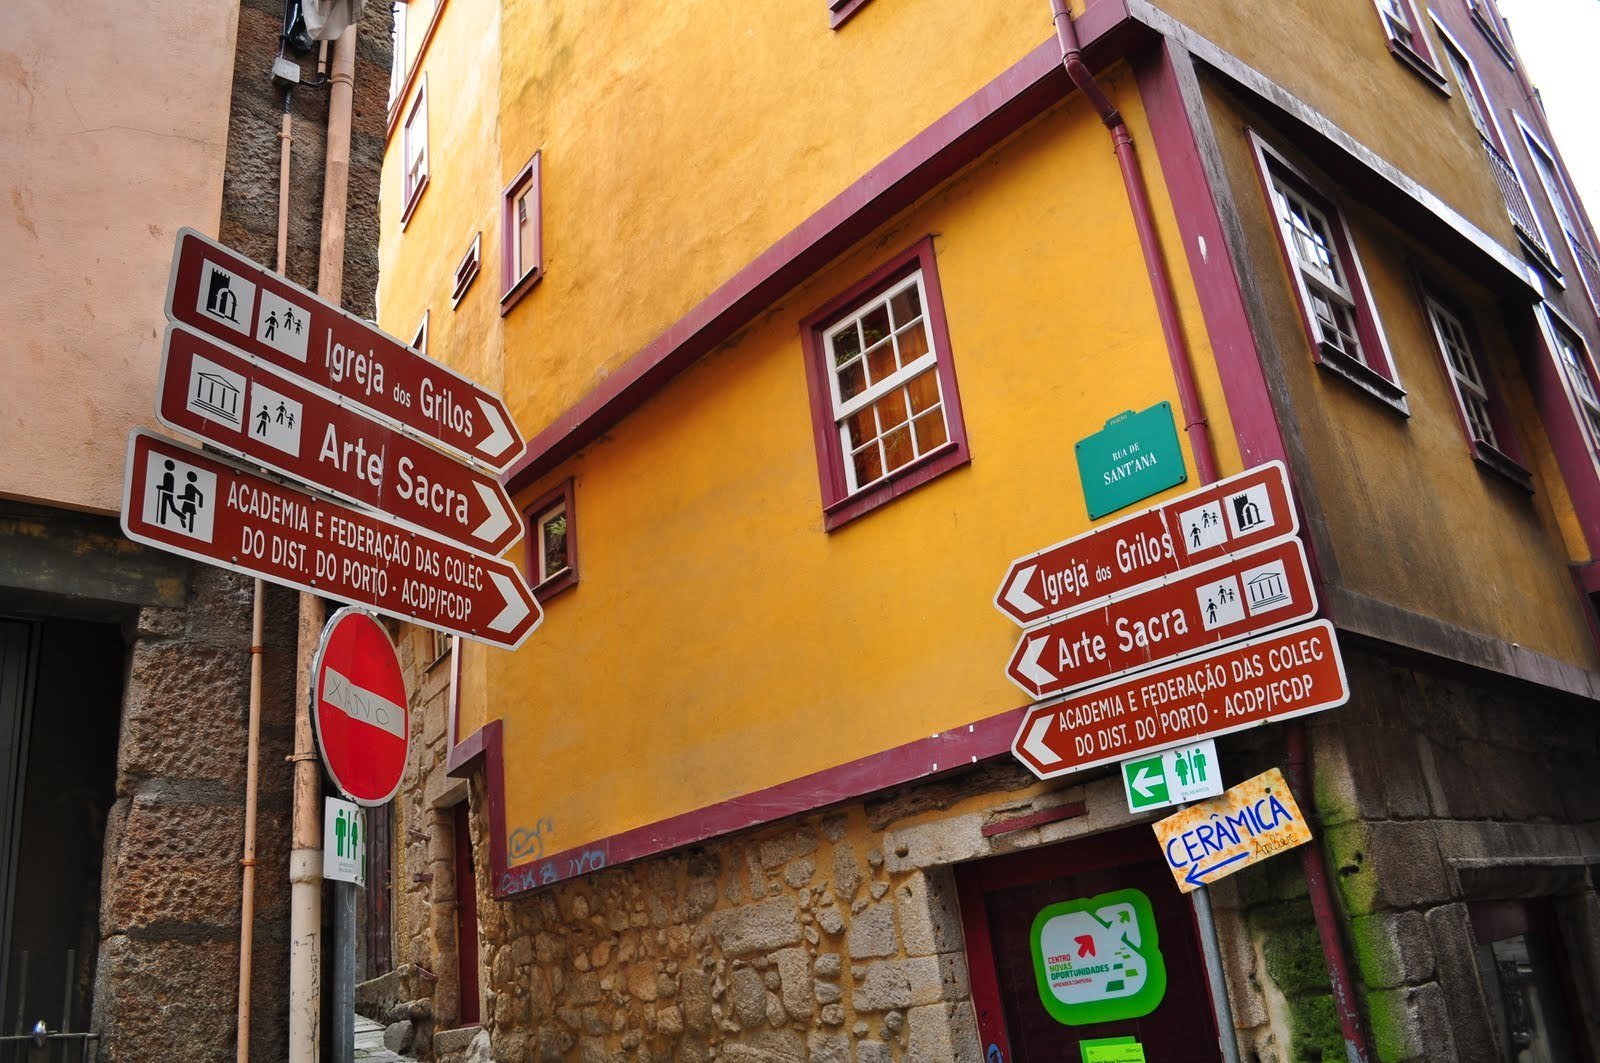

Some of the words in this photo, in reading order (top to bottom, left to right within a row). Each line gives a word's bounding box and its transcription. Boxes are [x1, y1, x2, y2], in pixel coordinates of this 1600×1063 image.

[325, 327, 385, 396] Igreja
[393, 382, 411, 408] dos
[420, 377, 473, 438] Grilos
[319, 422, 383, 487] Arte
[396, 456, 469, 526] Sacra
[1103, 452, 1158, 486] SANT'ANA
[1112, 448, 1128, 462] RUA
[1129, 442, 1140, 454] DE
[227, 480, 309, 534] ACADEMIA
[315, 511, 324, 538] E
[330, 517, 411, 569] FEDERAÇÃO
[415, 545, 441, 577] DAS
[445, 554, 484, 592] COLEC
[1041, 558, 1089, 605] Igreja
[1095, 565, 1112, 582] dos
[1116, 531, 1174, 574] Grilos
[242, 525, 265, 560] DO
[271, 535, 309, 574] DIST.
[315, 549, 337, 582] DO
[343, 557, 388, 597] PORTO
[401, 577, 472, 622] ACDP/FCDP
[1058, 630, 1107, 673] Arte
[1115, 608, 1189, 652] Sacra
[1058, 694, 1125, 732] ACADEMIA
[1128, 691, 1138, 712] E
[1140, 663, 1227, 707] FEDERAÇÃO
[1231, 654, 1264, 683] DAS
[1268, 636, 1324, 672] COLEC
[1075, 733, 1094, 757] DO
[1097, 723, 1132, 751] DIST.
[1135, 716, 1156, 741] DO
[1162, 702, 1209, 735] PORTO
[1224, 674, 1313, 718] ACDP/FCDP
[1167, 795, 1293, 868] CERÂMICA
[1048, 954, 1071, 964] CENTRO
[1050, 962, 1072, 972] NOVAS
[1051, 964, 1109, 980] OPORTUNIDADES
